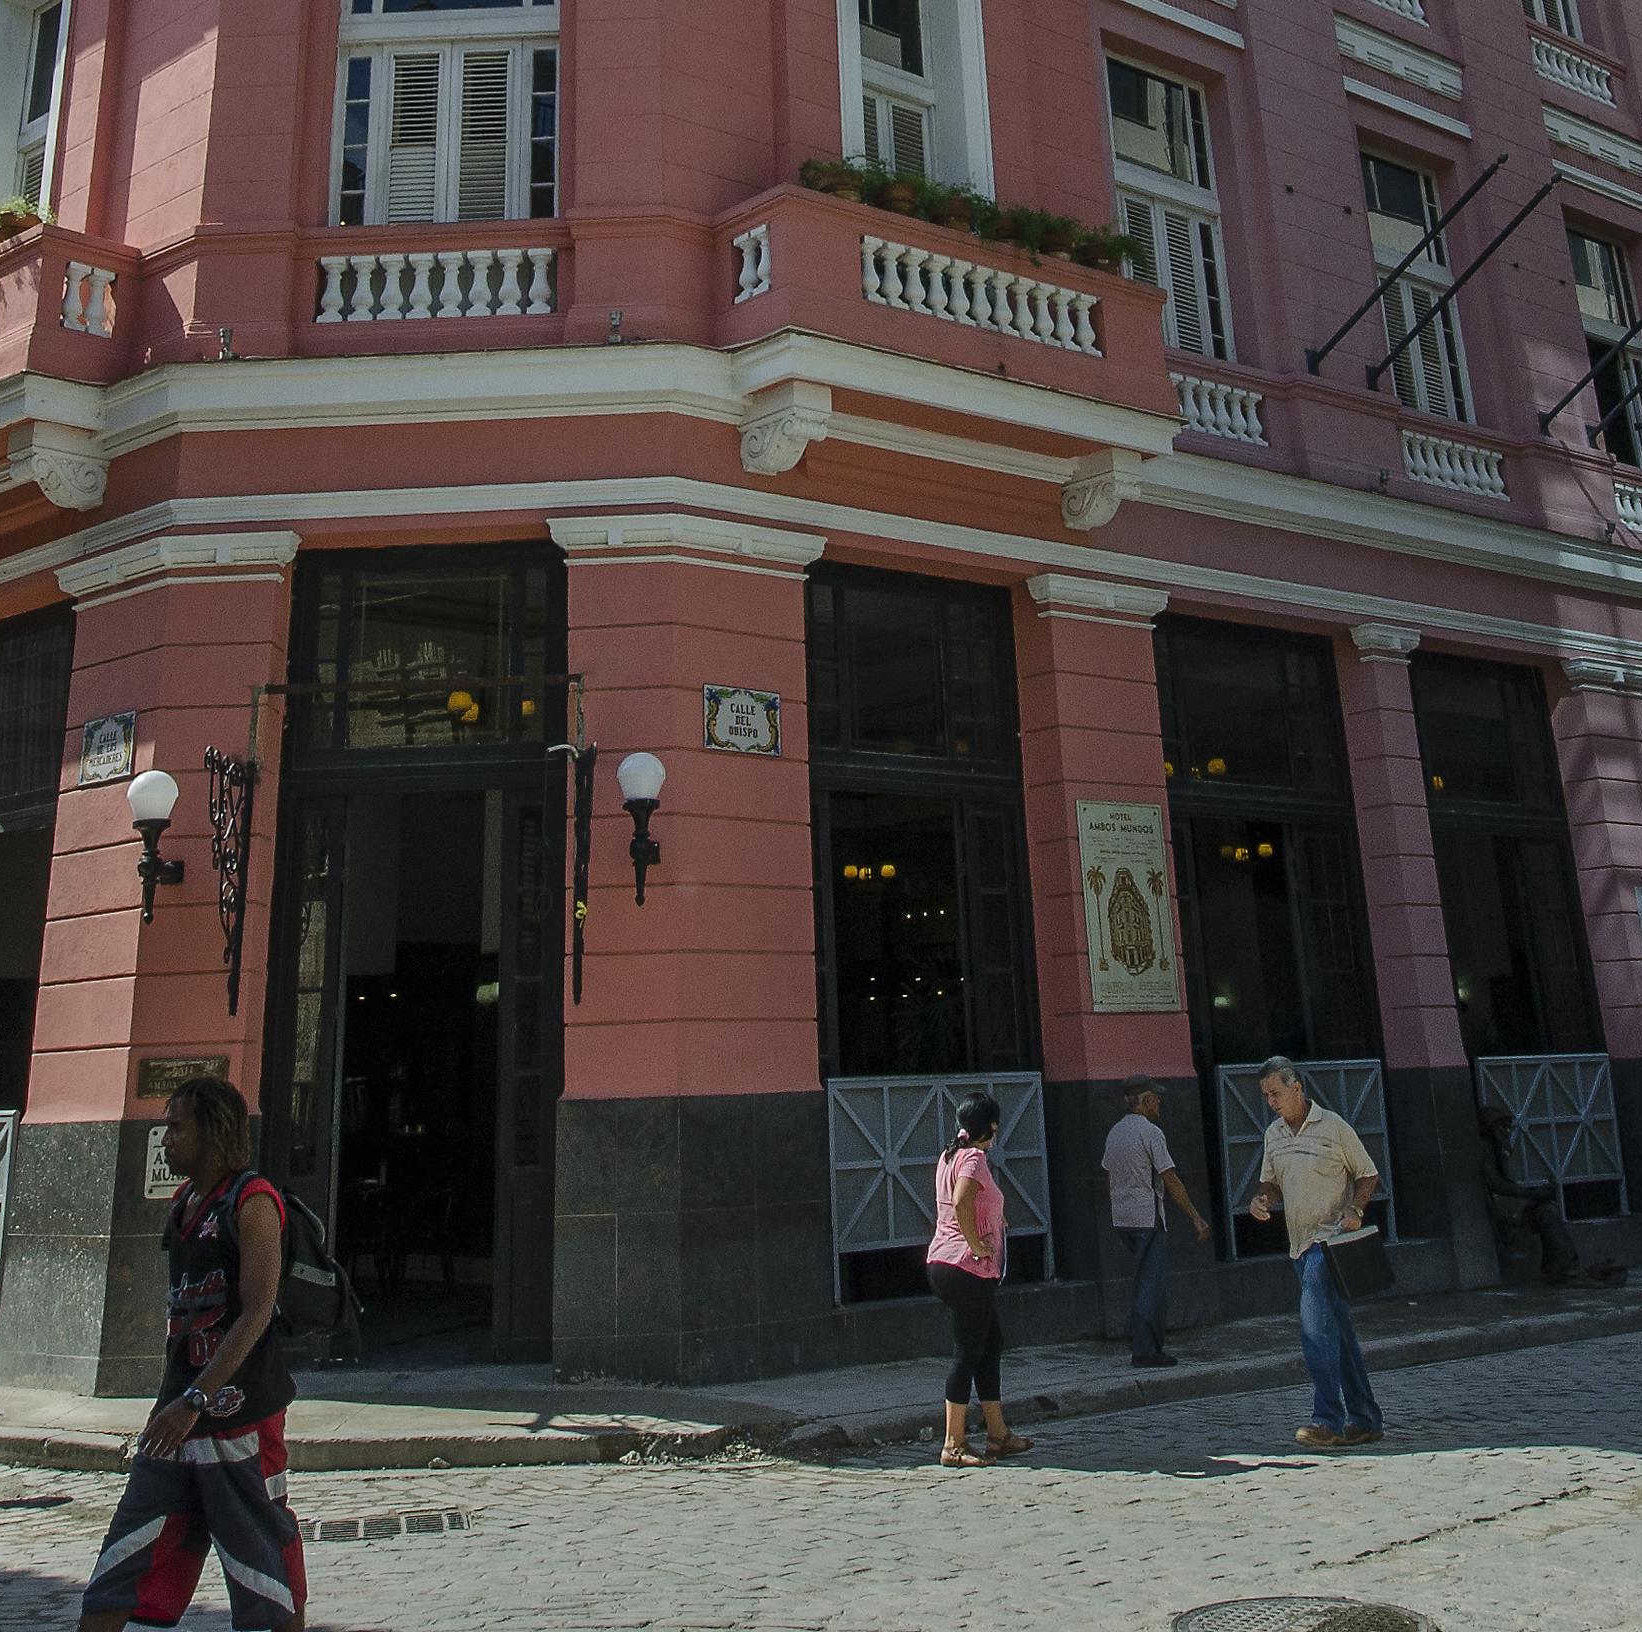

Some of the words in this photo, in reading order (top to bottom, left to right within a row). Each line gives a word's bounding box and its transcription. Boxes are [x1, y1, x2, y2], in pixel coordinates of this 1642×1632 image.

[730, 703, 756, 715] CALLE
[735, 715, 752, 726] DEL
[728, 726, 758, 738] OBISPO
[1109, 812, 1132, 822] HOTEL
[1088, 821, 1116, 833] AMBOS
[1120, 824, 1154, 834] MUNDOS
